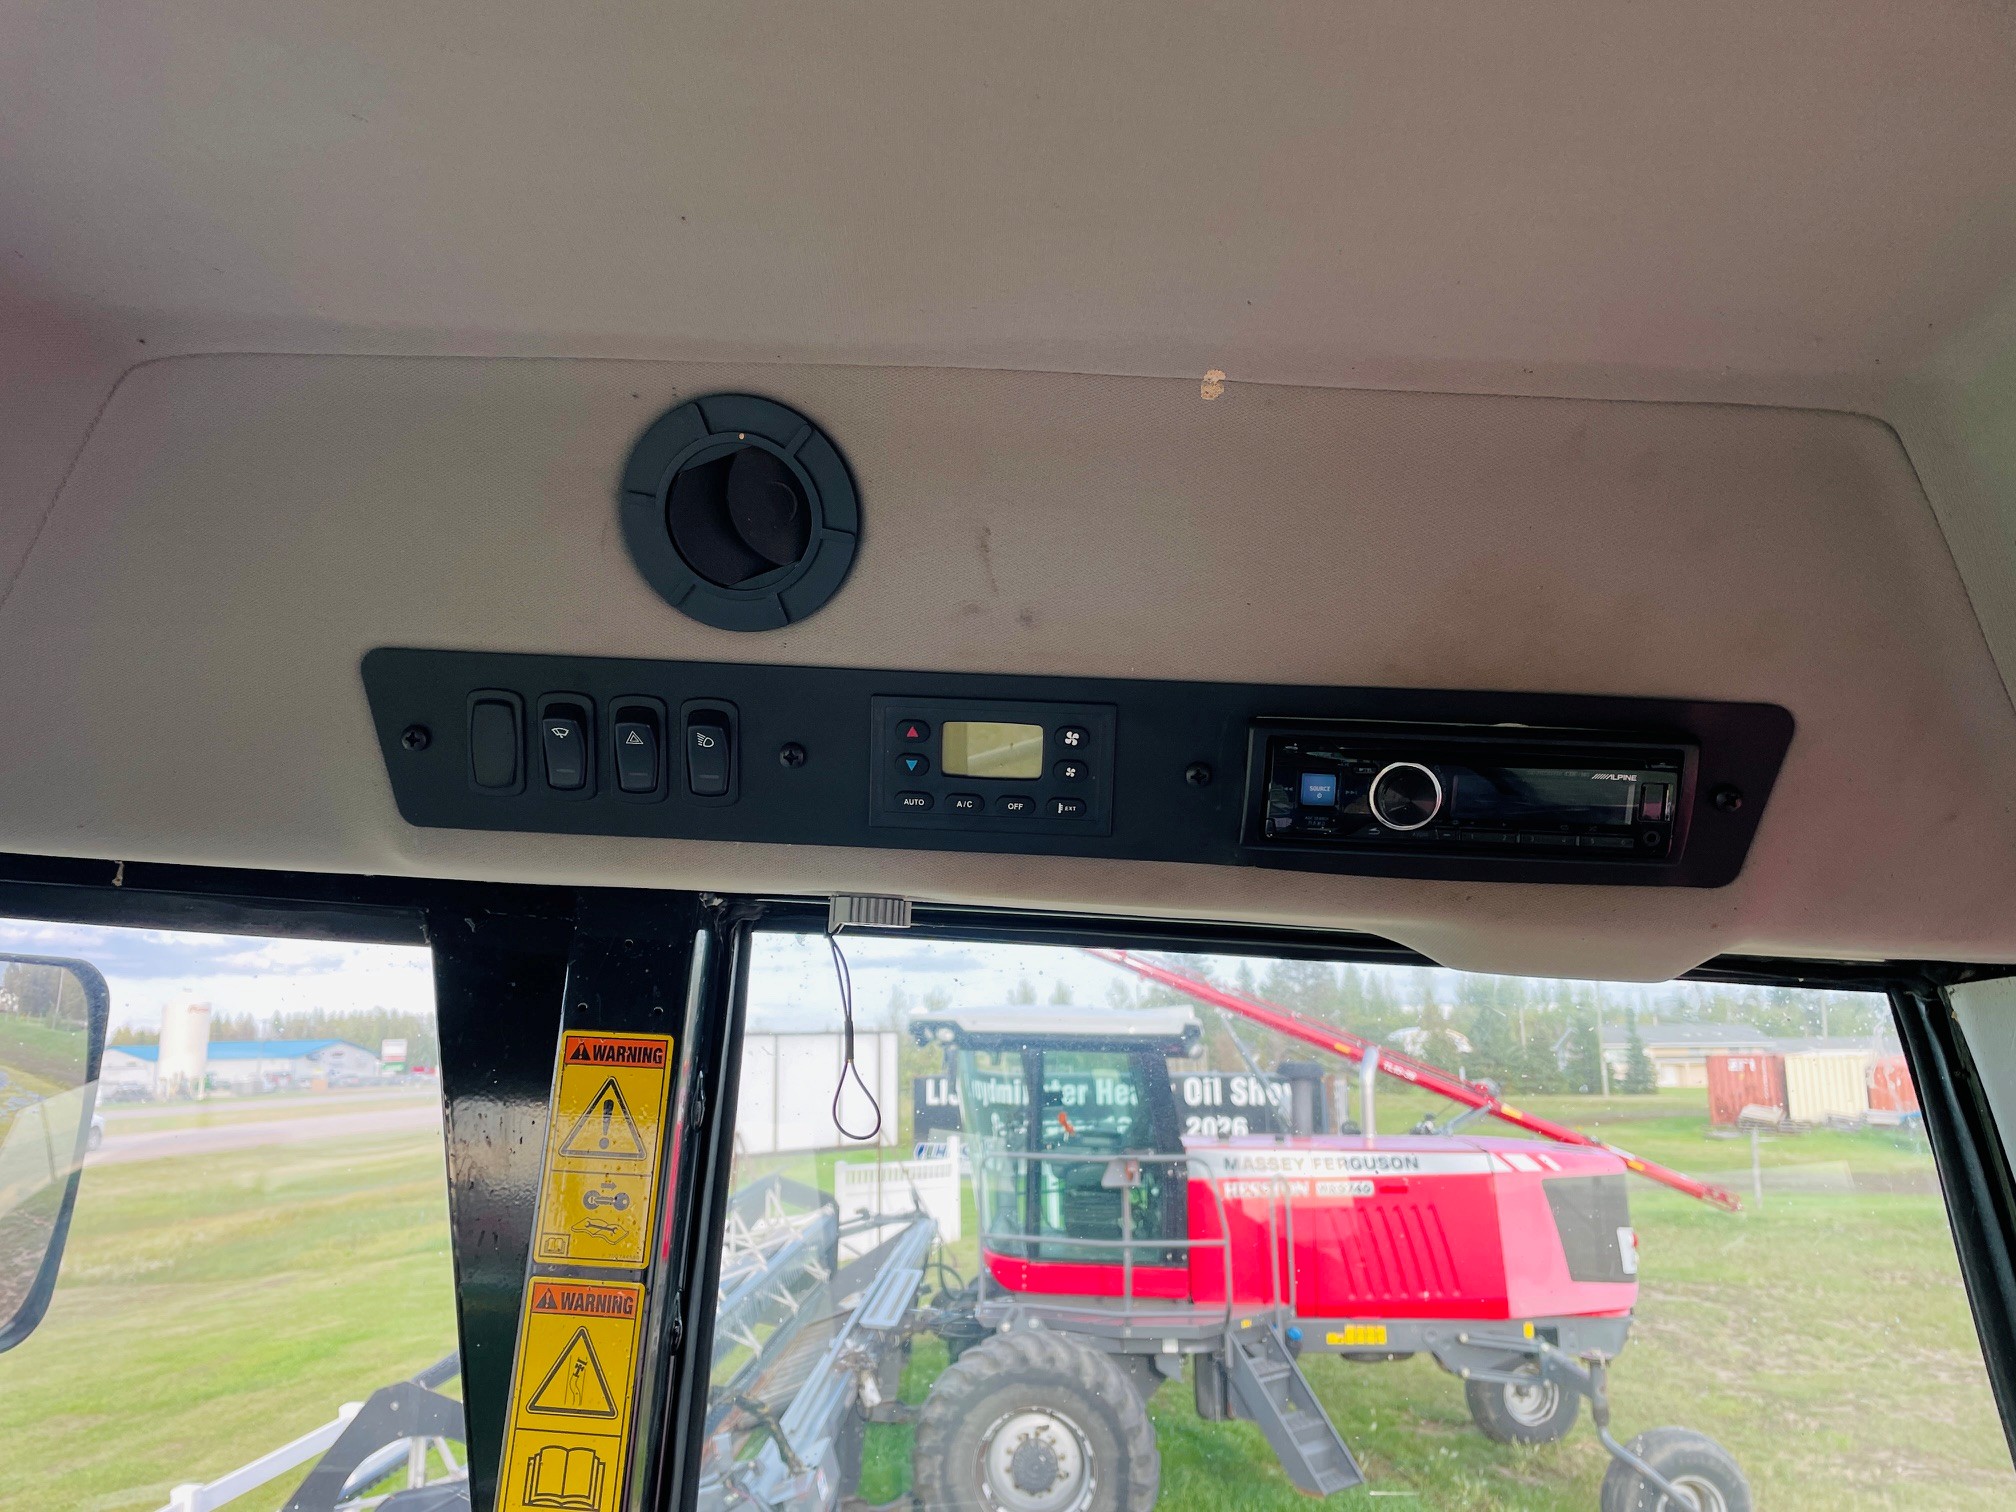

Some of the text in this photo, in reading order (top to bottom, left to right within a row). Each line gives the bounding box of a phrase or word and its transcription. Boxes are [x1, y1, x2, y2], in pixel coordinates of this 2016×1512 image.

[1606, 773, 1638, 782] ALPINE
[903, 797, 925, 806] AUTO
[956, 800, 973, 808] A/C
[1007, 802, 1024, 811] OFF
[593, 1044, 664, 1064] WARNING
[1183, 1076, 1222, 1107] Oil
[1186, 1116, 1249, 1137] 2026
[1223, 1155, 1419, 1173] MASSEY FERGUSON
[561, 1291, 634, 1315] WARNING
